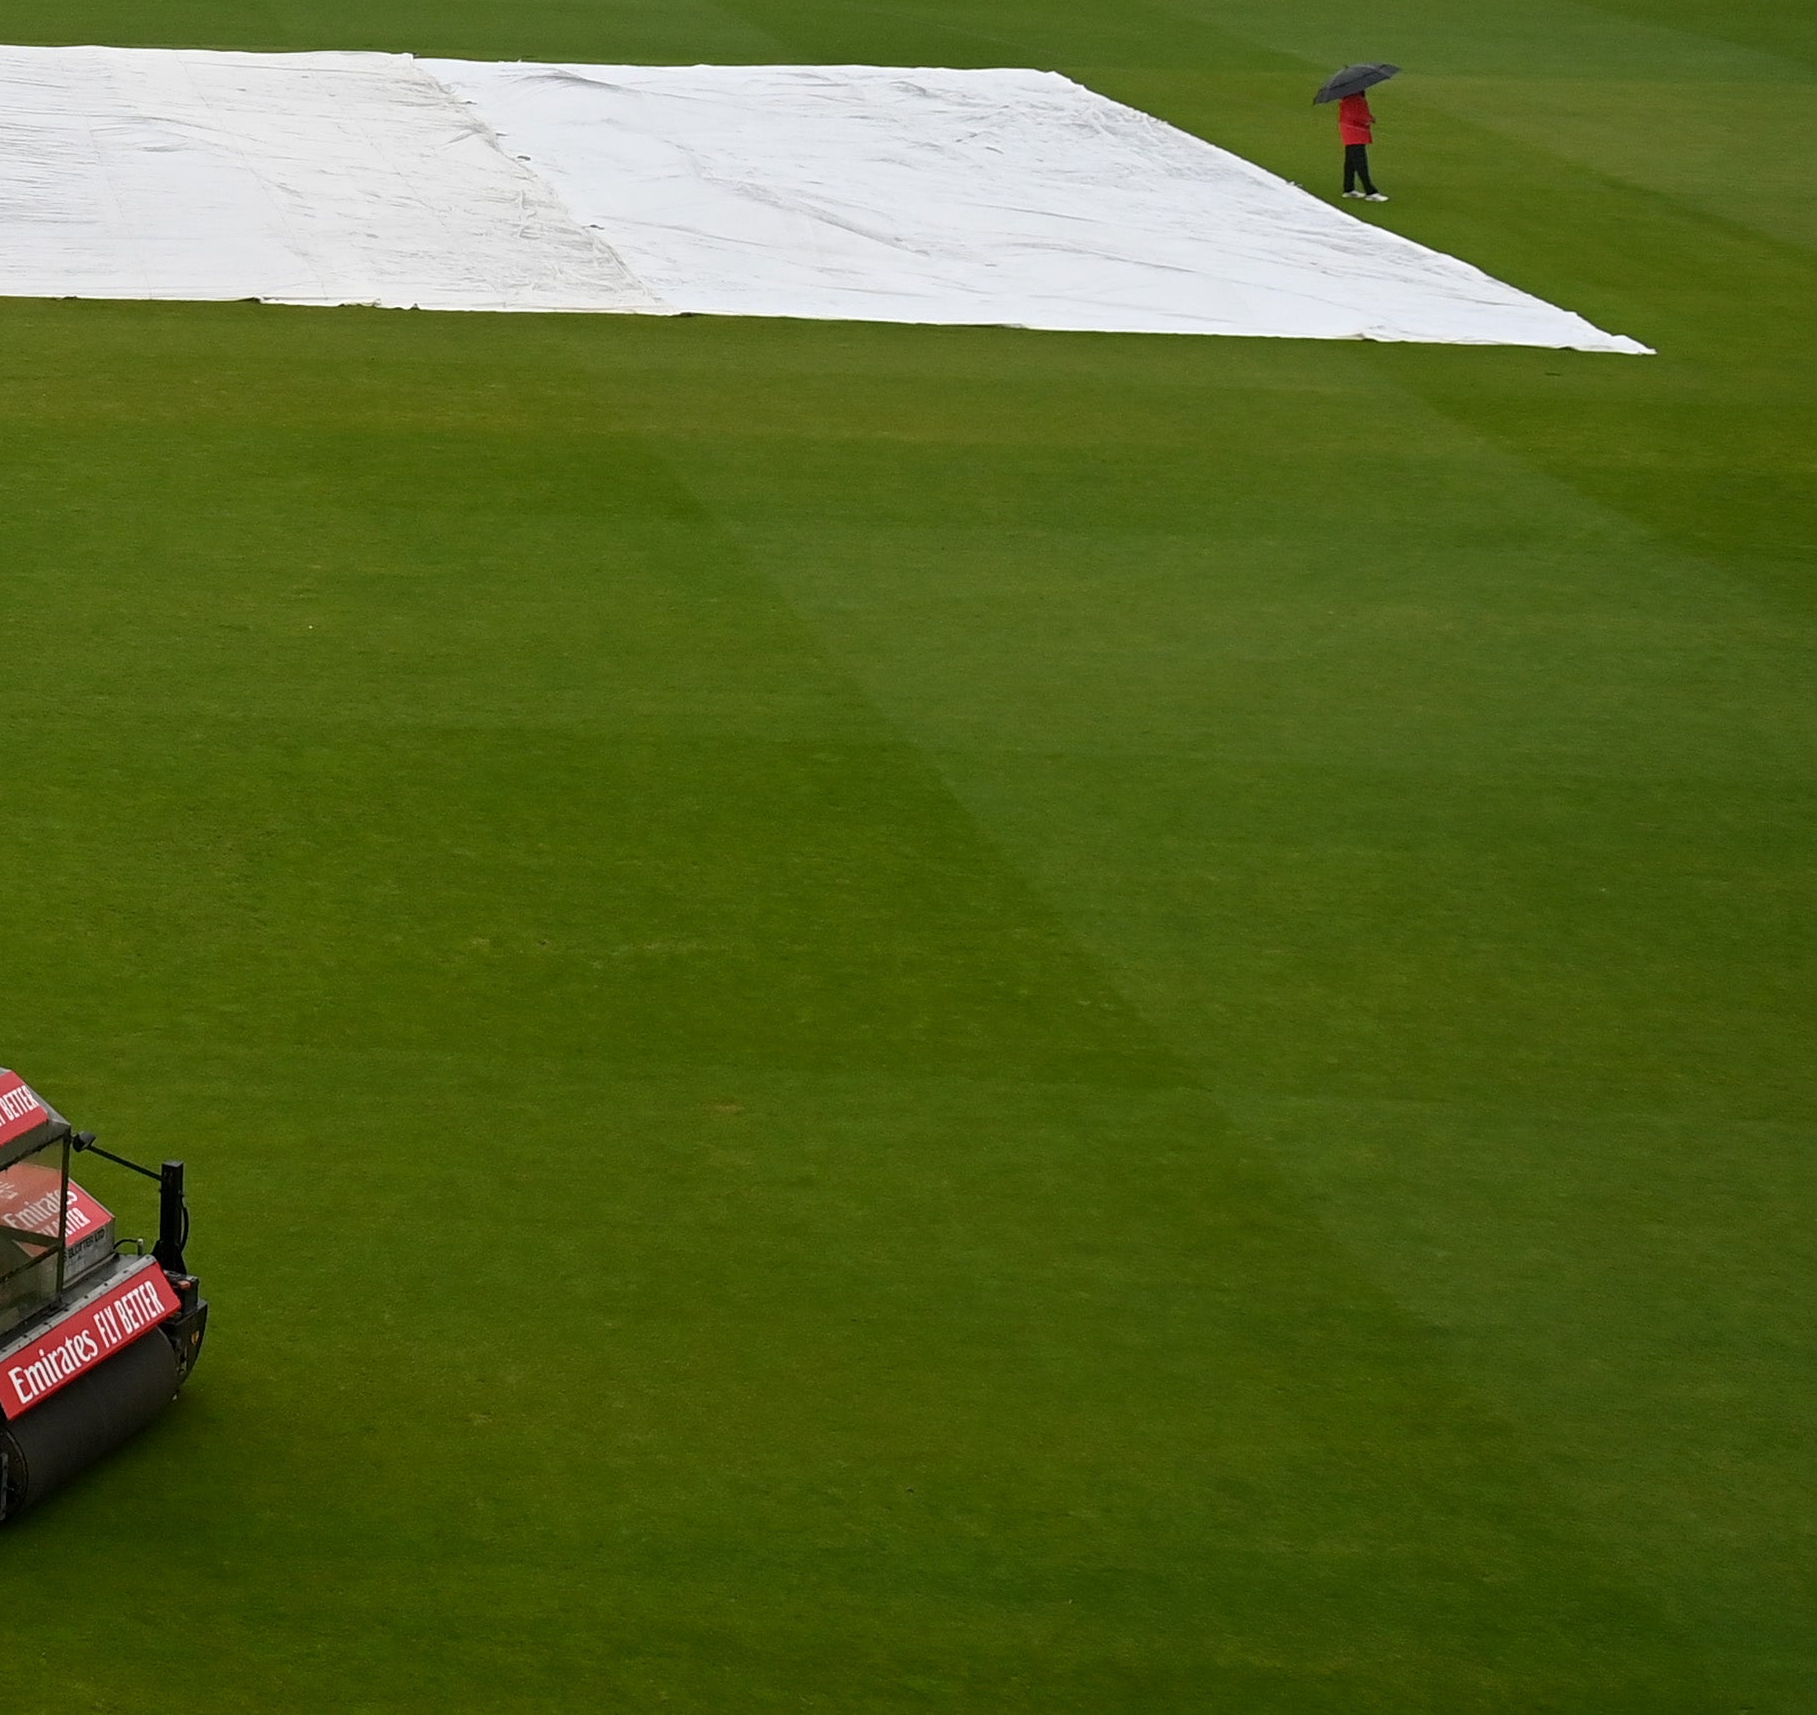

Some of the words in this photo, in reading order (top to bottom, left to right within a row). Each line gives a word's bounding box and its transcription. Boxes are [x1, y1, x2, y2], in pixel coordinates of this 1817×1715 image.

[7, 1330, 99, 1404] Emirates
[93, 1306, 123, 1348] FLY
[114, 1280, 165, 1335] BETTER
